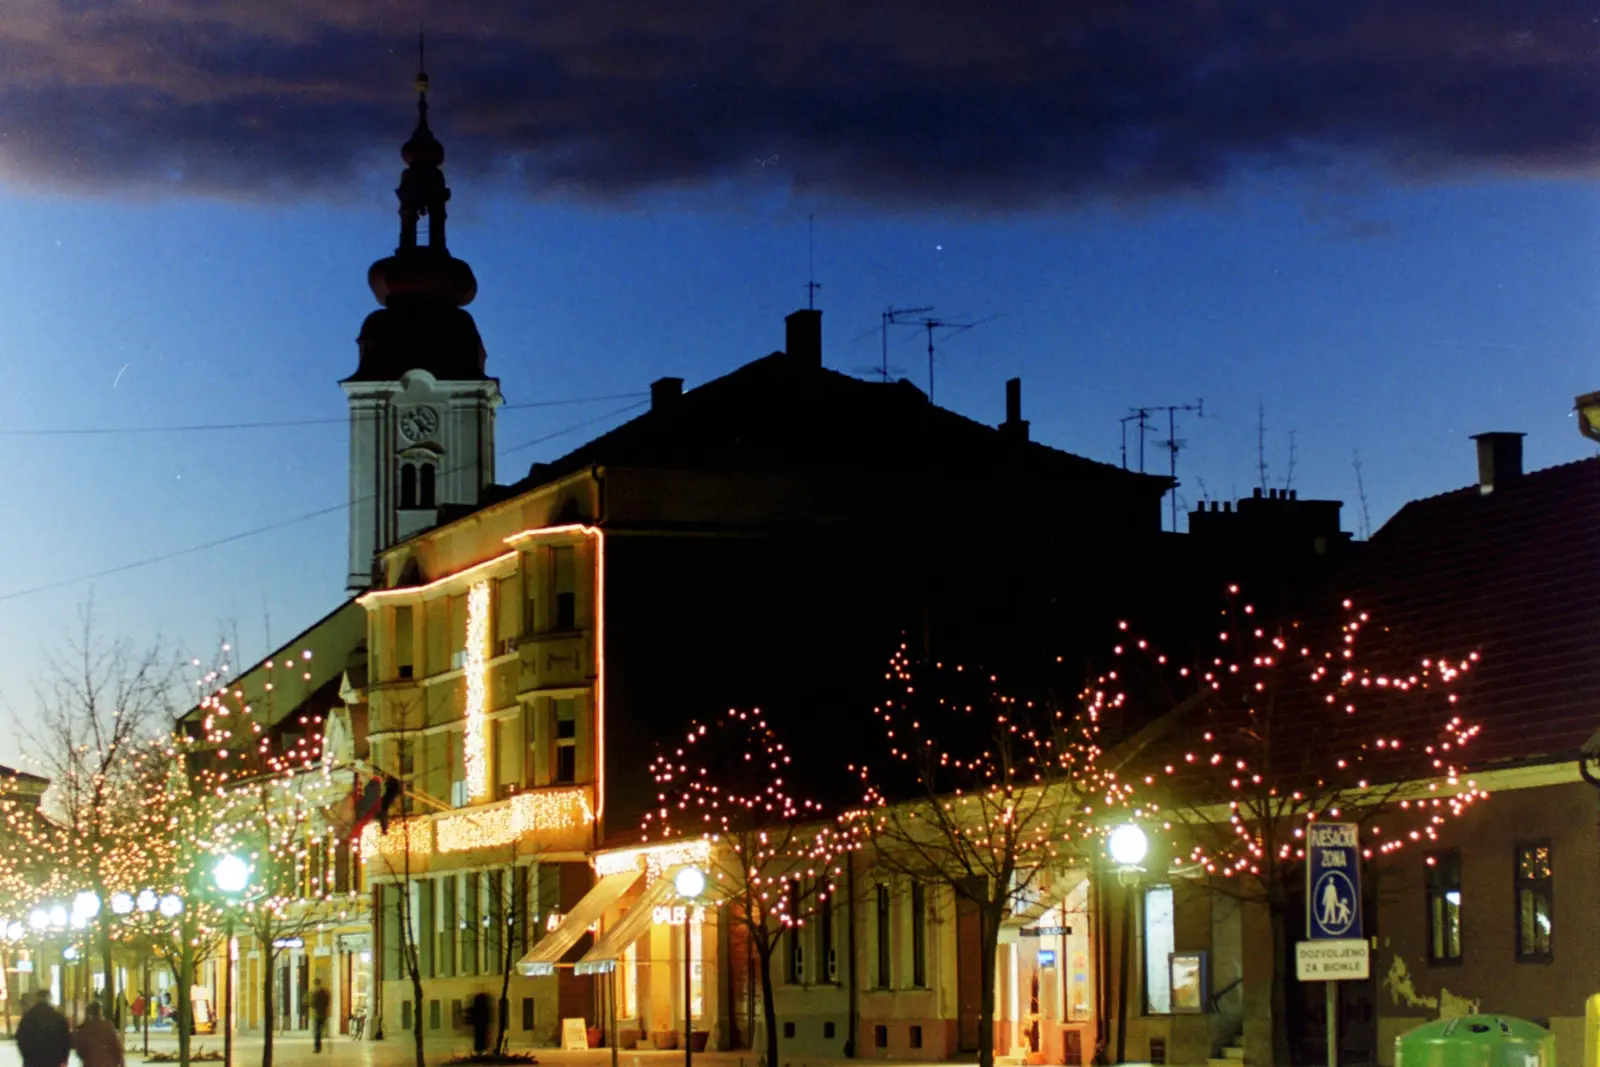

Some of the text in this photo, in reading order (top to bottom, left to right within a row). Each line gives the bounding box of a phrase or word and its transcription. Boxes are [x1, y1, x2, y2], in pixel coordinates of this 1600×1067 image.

[1321, 850, 1346, 867] ZONA
[1300, 948, 1366, 959] DOZVOLJENO
[1305, 961, 1361, 973] ZA BICIKLE
